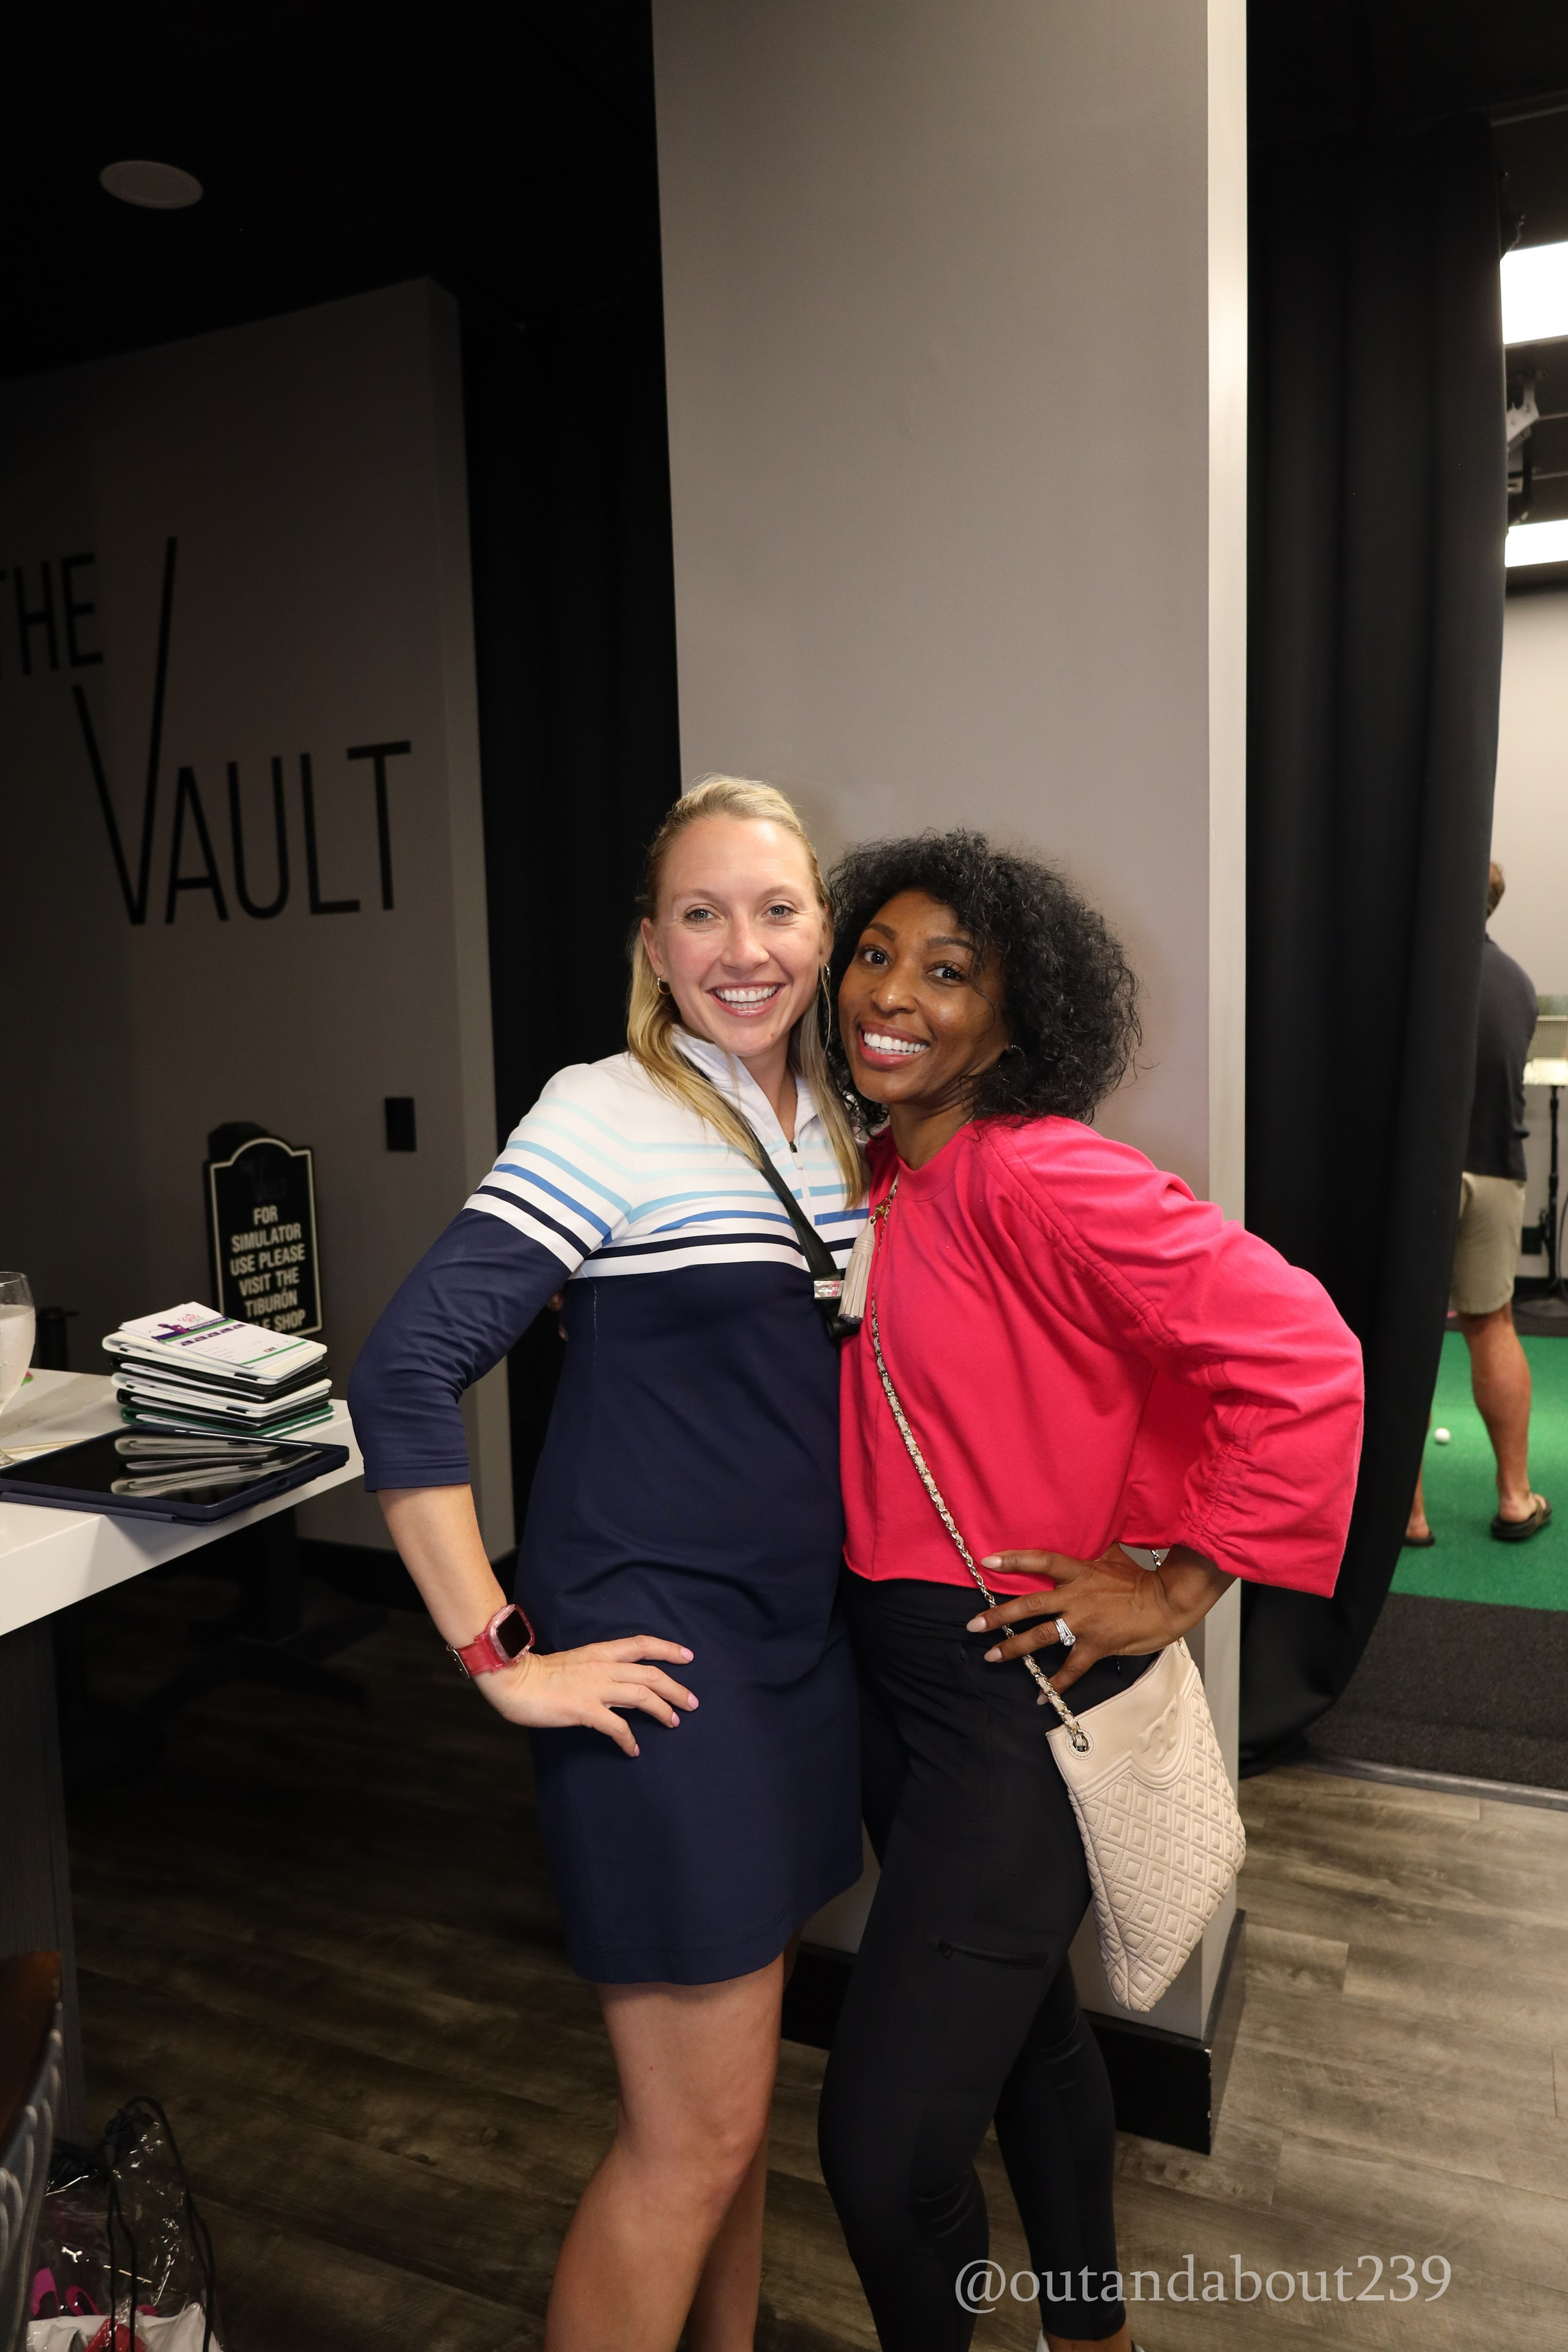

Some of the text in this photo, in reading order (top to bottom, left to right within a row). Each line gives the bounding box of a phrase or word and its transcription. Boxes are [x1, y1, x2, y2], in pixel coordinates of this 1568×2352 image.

[0, 554, 103, 674] HE
[72, 537, 412, 925] VAULT
[253, 1204, 279, 1226] FOR
[231, 1222, 302, 1253] SIMULATOR
[229, 1243, 306, 1276] USE PLEASE
[238, 1266, 300, 1297] VISIT THE
[244, 1287, 298, 1318] TIBURÓN
[273, 1308, 307, 1332] SHOP
